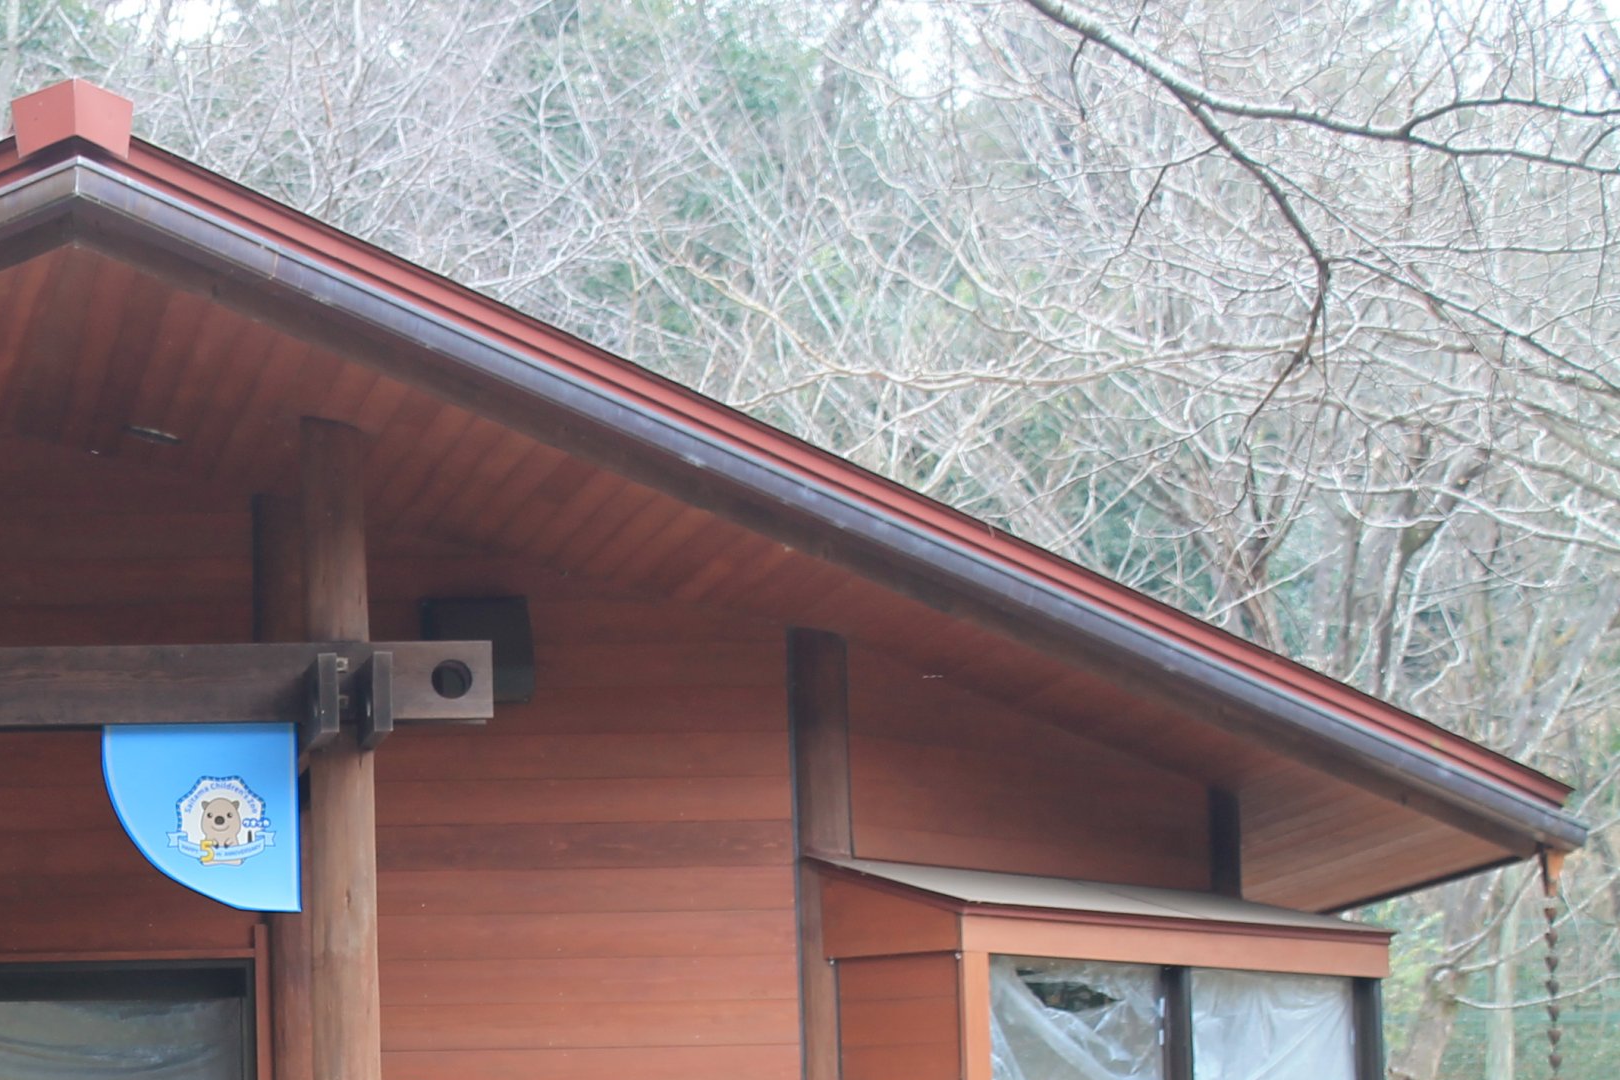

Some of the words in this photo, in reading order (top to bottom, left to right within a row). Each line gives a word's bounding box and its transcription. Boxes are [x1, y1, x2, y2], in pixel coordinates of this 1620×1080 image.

[185, 786, 209, 813] Saitama
[210, 783, 248, 799] Children's
[247, 798, 258, 814] Zoo
